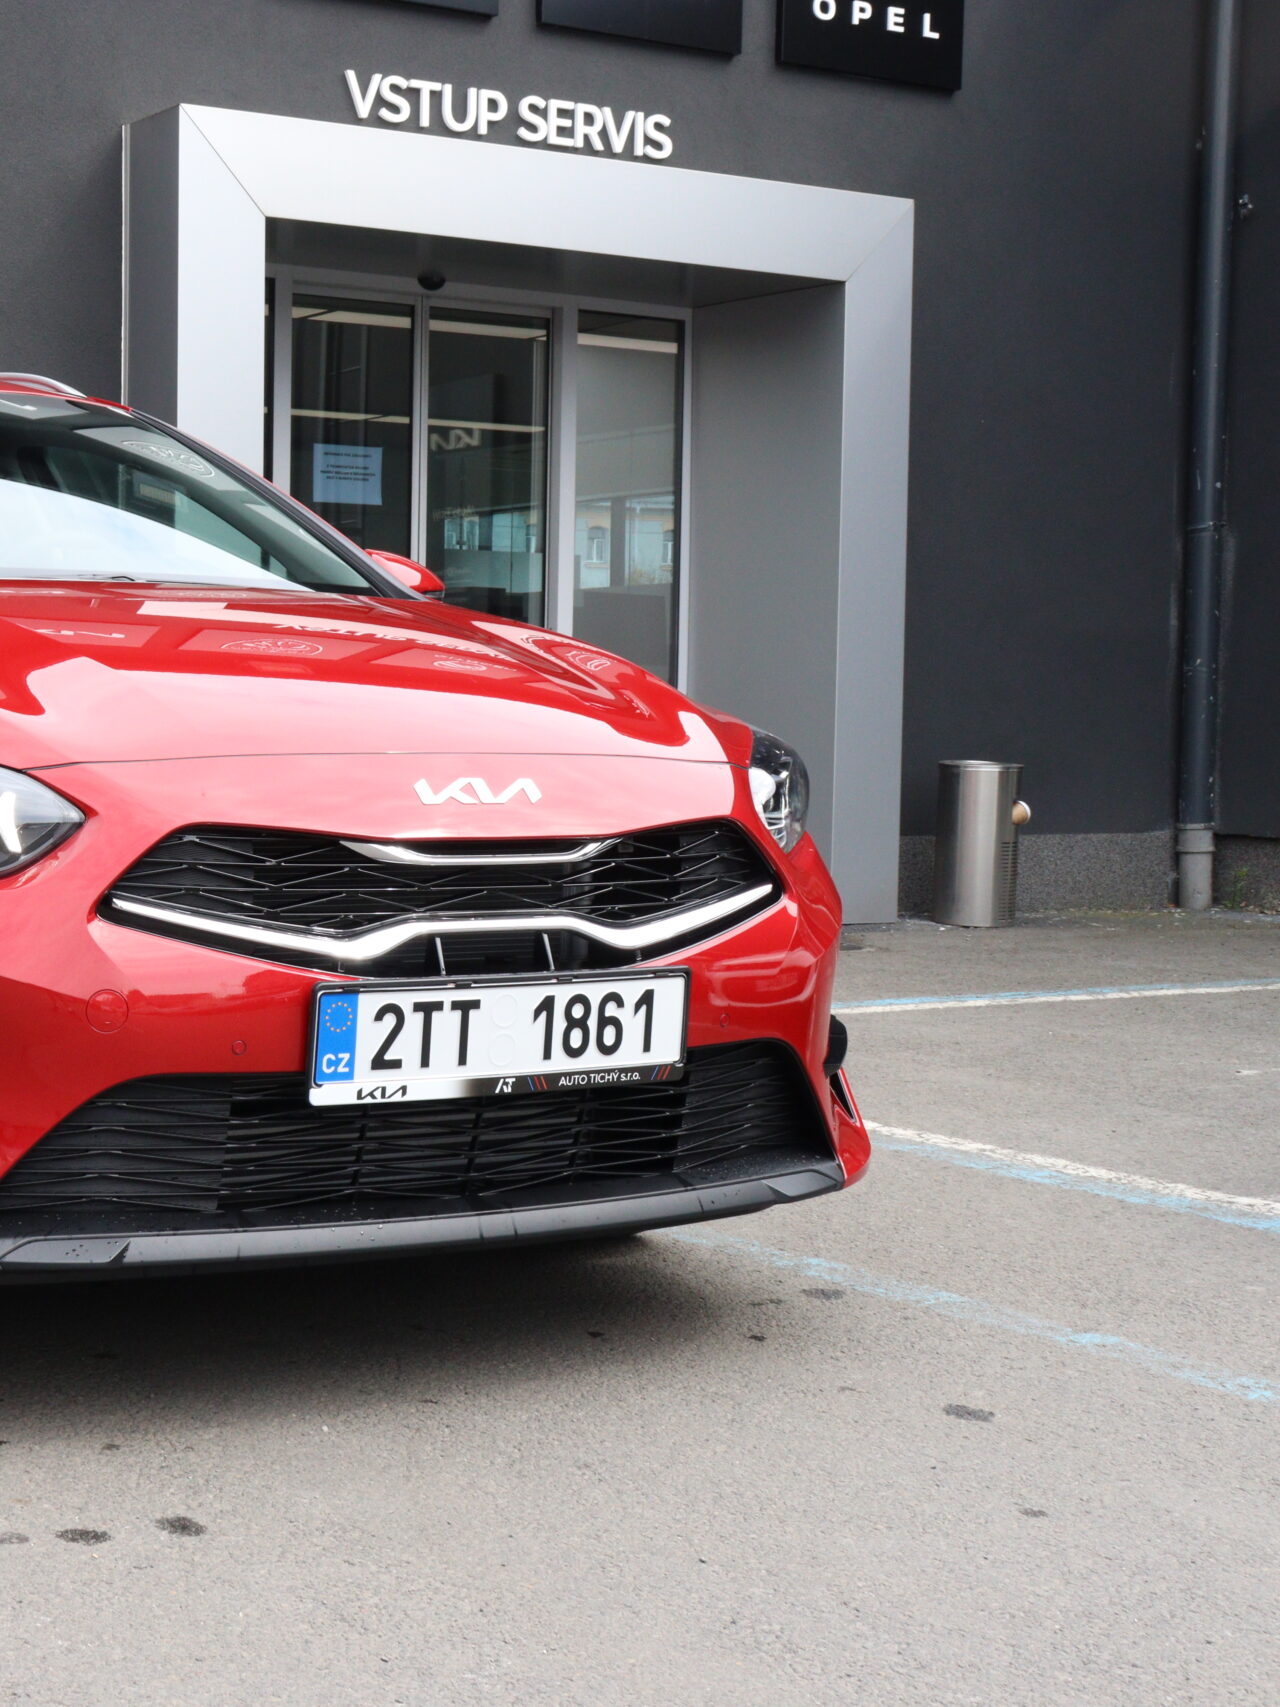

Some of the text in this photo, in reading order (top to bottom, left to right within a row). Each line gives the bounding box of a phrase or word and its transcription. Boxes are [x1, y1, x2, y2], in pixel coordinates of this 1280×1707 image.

[812, 0, 940, 39] OPEL
[344, 69, 673, 160] VSTUP SERVIS
[413, 778, 542, 805] KIA
[370, 988, 655, 1070] 2TT 1861
[322, 1053, 351, 1075] CZ
[558, 1070, 641, 1087] AUTO TICHÝ s.r.o.
[356, 1085, 408, 1101] KIA
